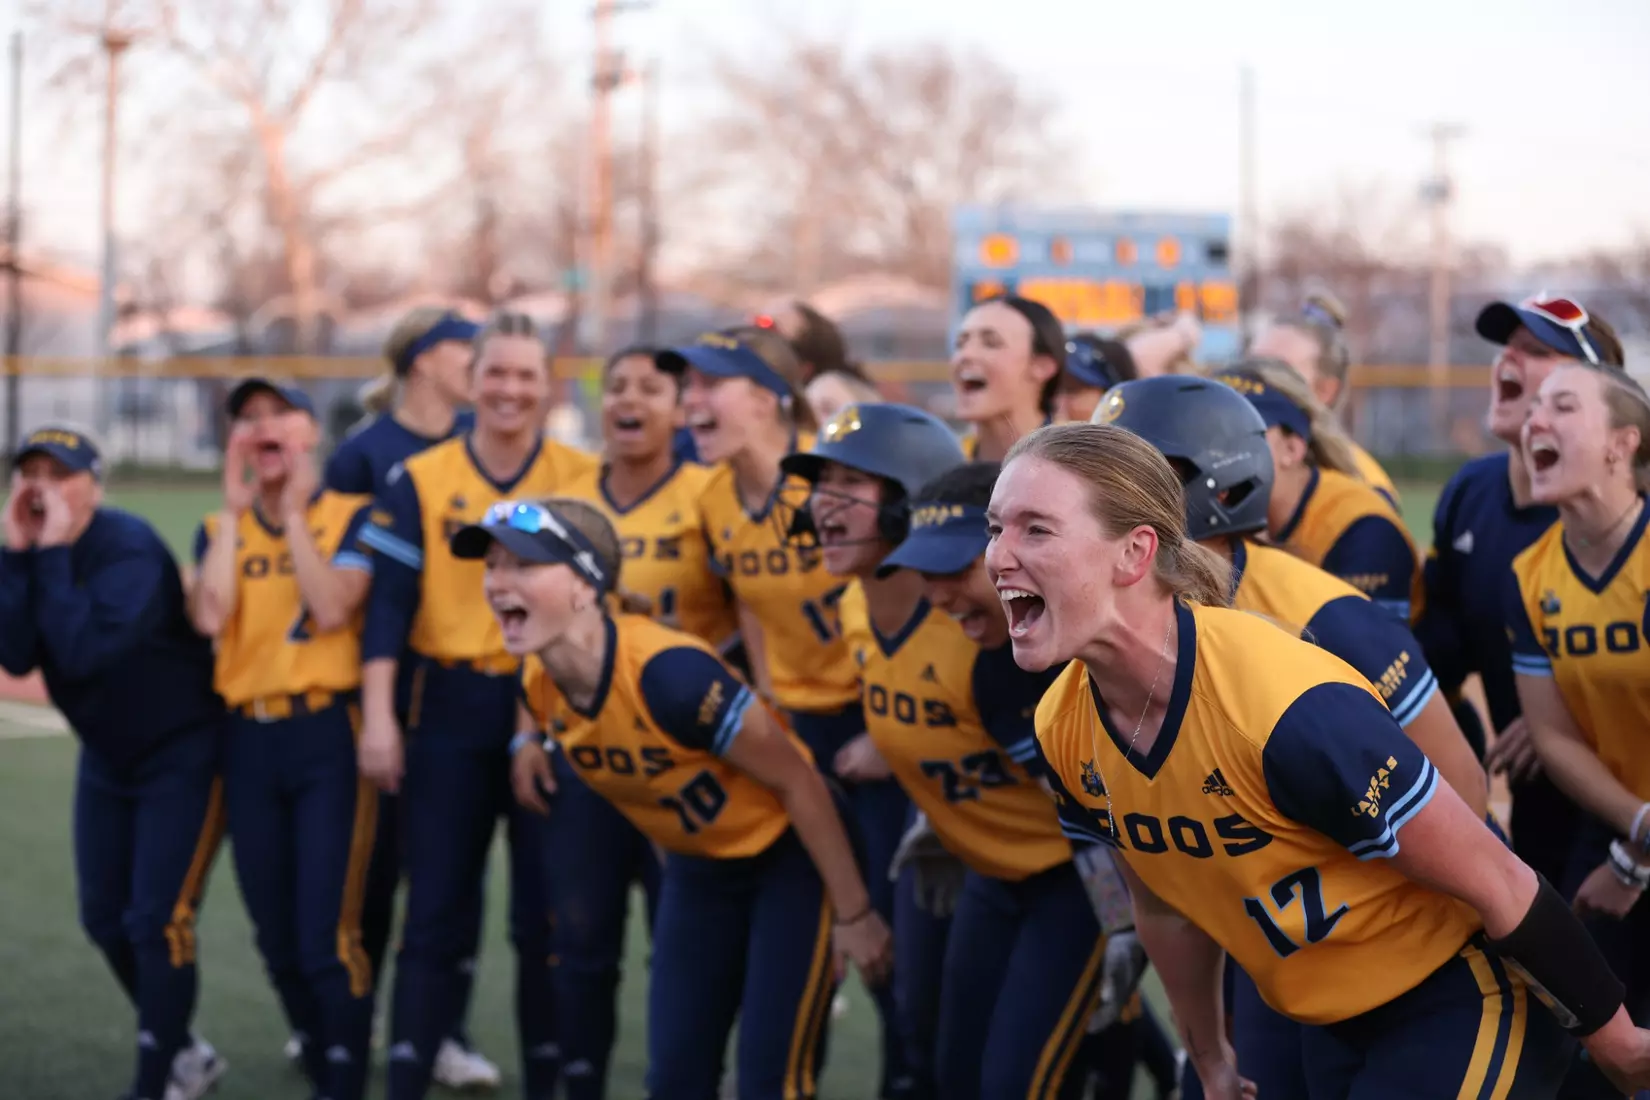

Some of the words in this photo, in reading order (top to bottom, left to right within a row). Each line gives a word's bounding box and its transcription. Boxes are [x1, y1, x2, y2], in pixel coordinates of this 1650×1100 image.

[1543, 621, 1641, 660] ROO
[868, 684, 957, 728] OOS
[570, 746, 676, 777] OOS
[658, 769, 728, 835] 10
[1242, 866, 1350, 958] 12
